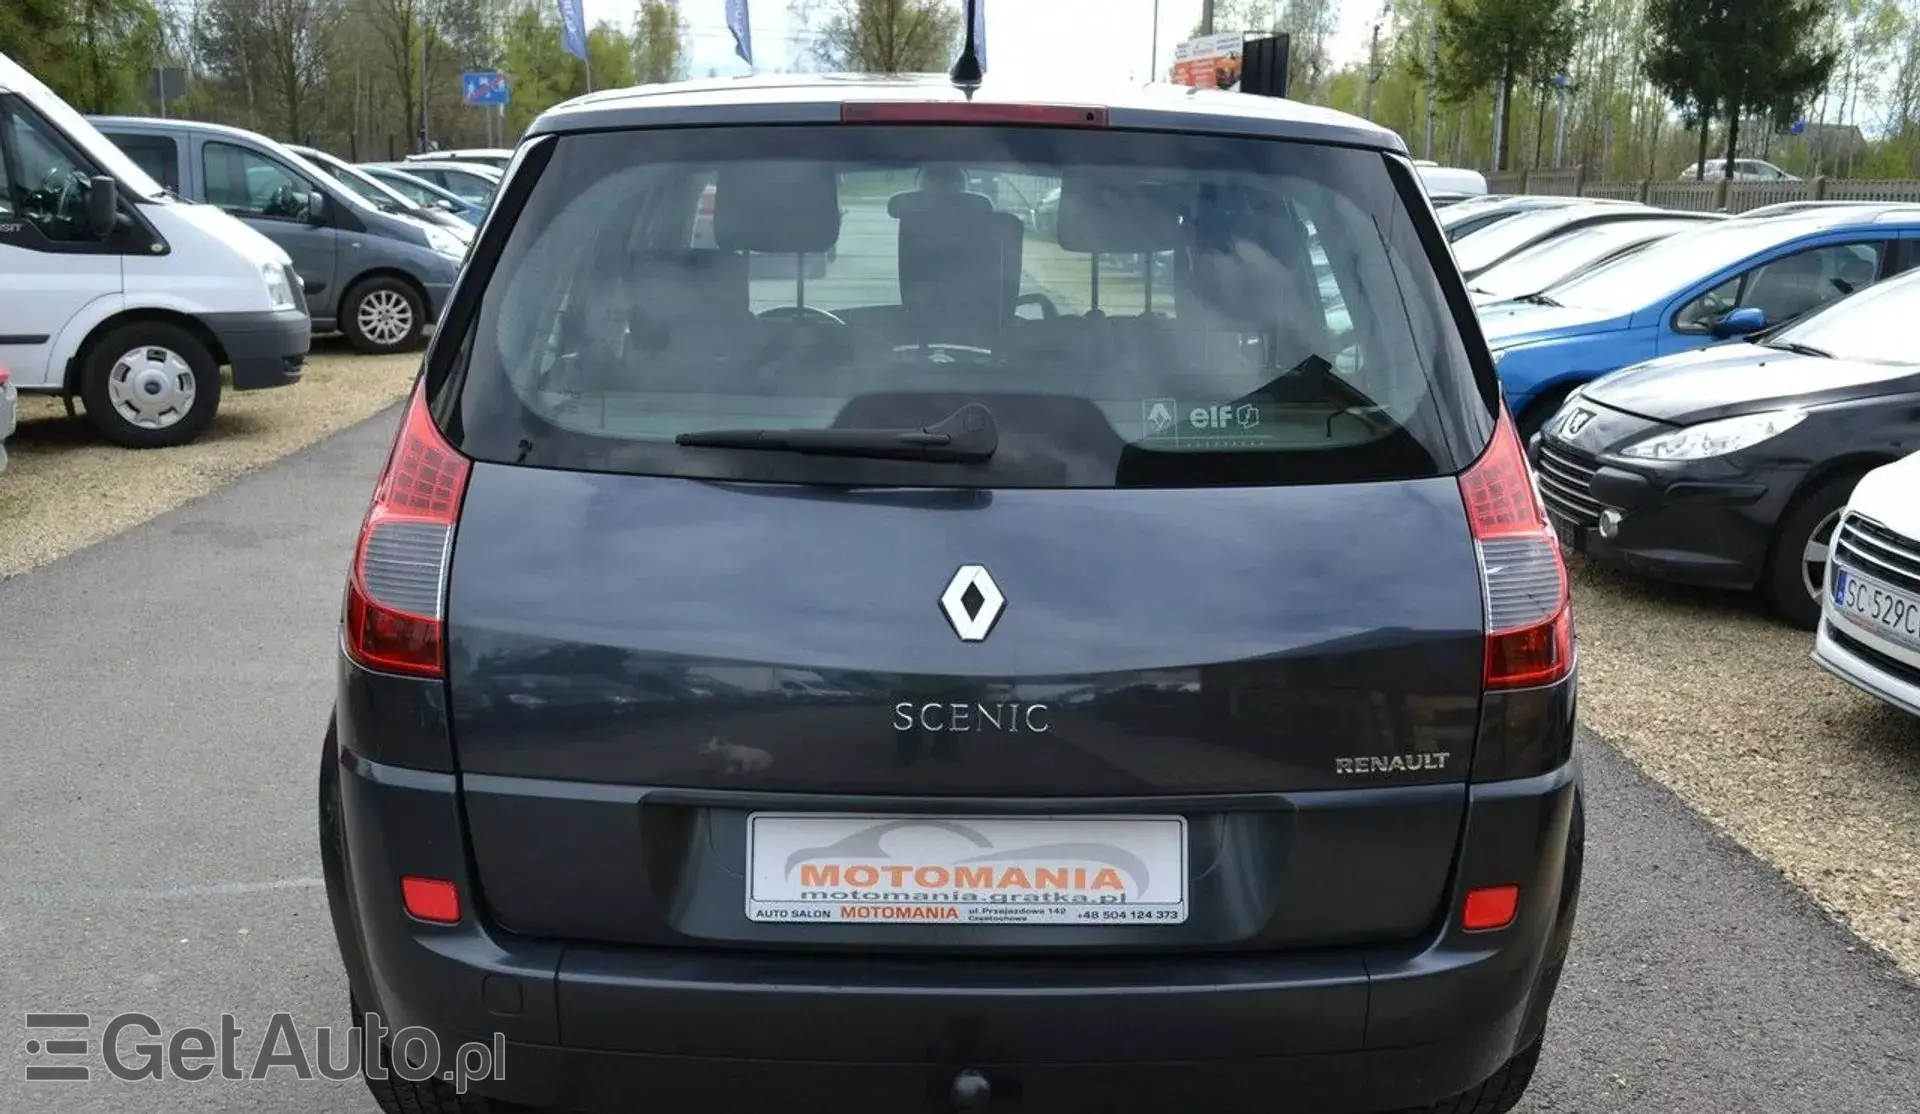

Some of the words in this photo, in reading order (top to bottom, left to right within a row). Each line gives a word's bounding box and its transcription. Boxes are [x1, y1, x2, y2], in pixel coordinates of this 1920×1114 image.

[1189, 405, 1233, 429] elf
[1846, 579, 1868, 613] SC
[1871, 589, 1920, 638] 529C
[893, 702, 1049, 733] SCENIC
[1336, 752, 1450, 774] RENAULT
[800, 864, 1126, 890] MOTOMANIA
[800, 890, 1127, 905] motomania.gratka.pl
[756, 909, 789, 919] AUTO
[791, 909, 832, 919] SALON
[839, 906, 959, 920] MOTOMANIA
[1077, 910, 1100, 919] +48
[1102, 910, 1127, 919] 504
[1130, 910, 1152, 919] 124
[1156, 910, 1179, 919] 373
